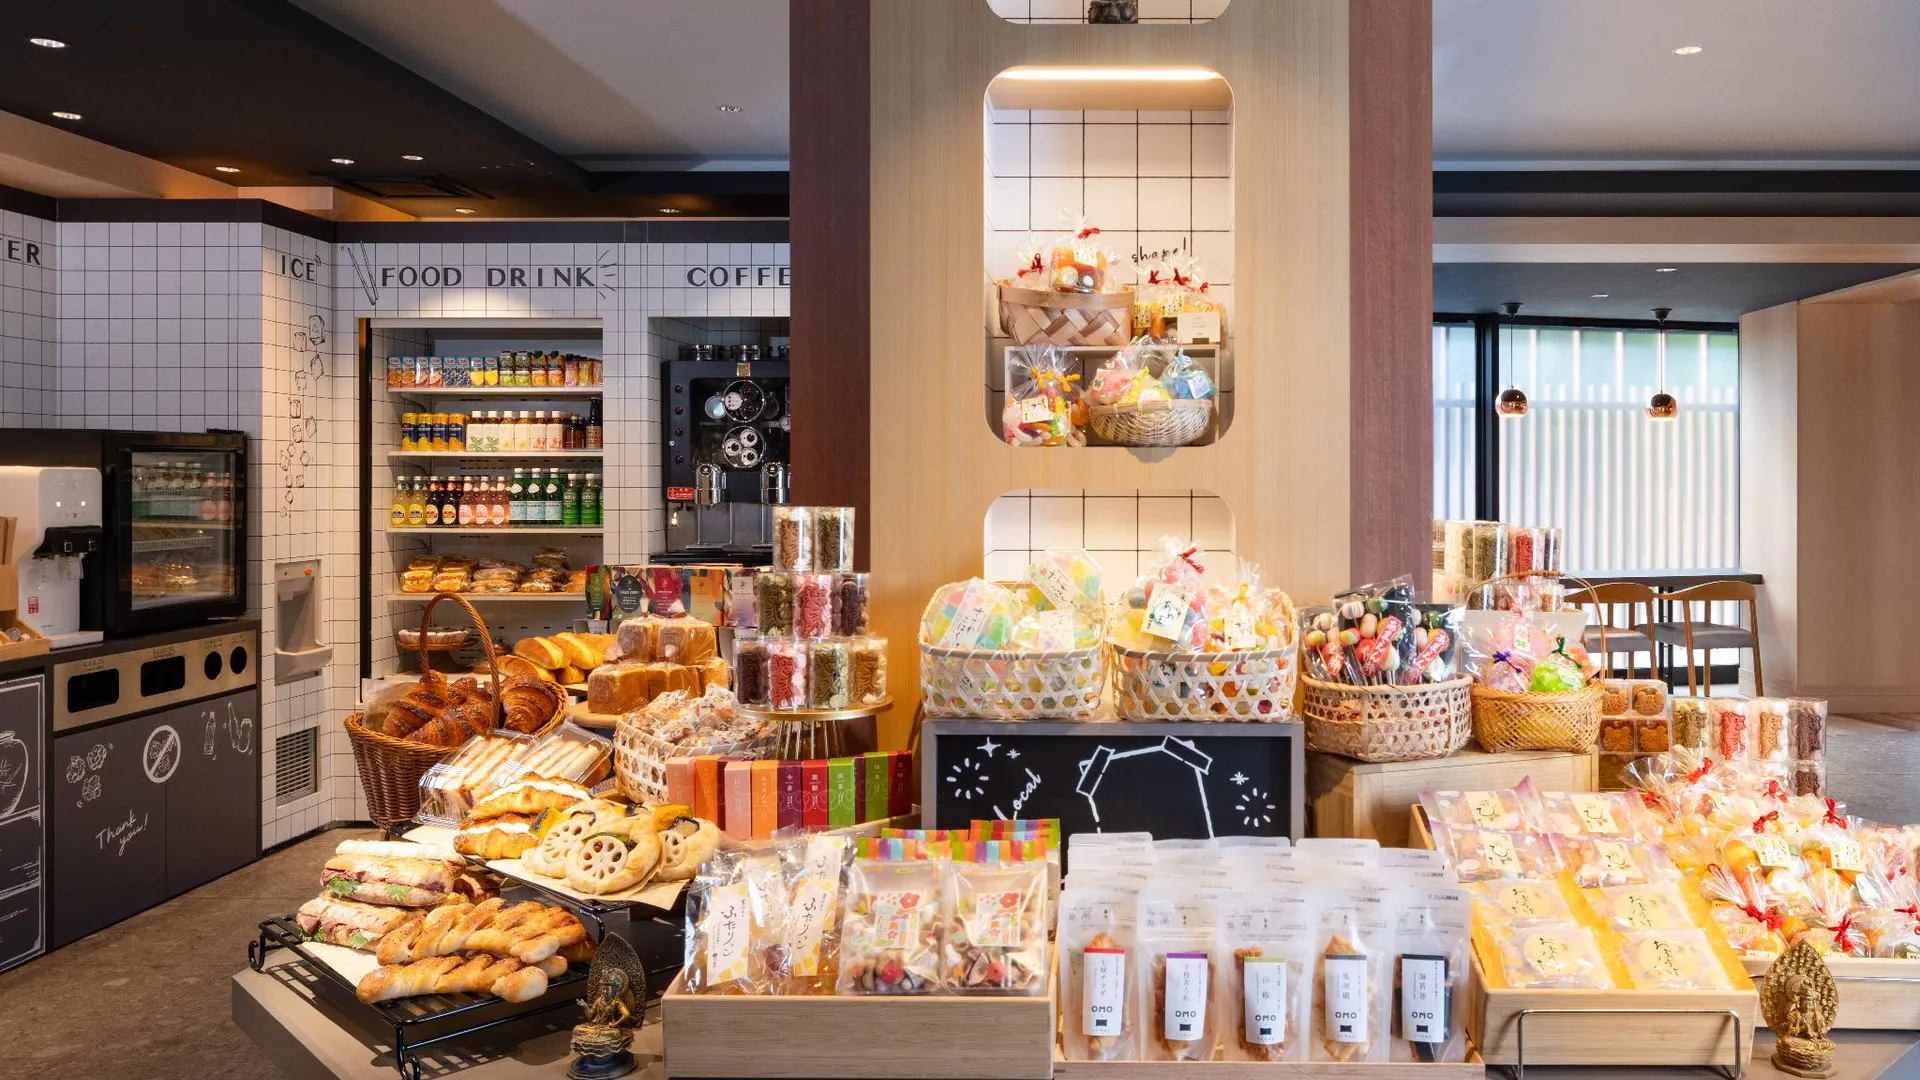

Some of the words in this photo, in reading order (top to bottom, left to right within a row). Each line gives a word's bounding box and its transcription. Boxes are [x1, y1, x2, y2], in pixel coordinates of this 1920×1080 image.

[0, 238, 41, 265] ER
[281, 254, 316, 281] ICE
[381, 266, 463, 288] FOOD
[487, 266, 596, 288] DRINK
[95, 809, 137, 850] Thank
[118, 813, 149, 857] you!
[1091, 1005, 1113, 1013] OMO
[1175, 1010, 1197, 1018] OMO
[1335, 1011, 1357, 1019] OMO
[1411, 1011, 1434, 1020] OMO
[1255, 1014, 1277, 1022] OMO
